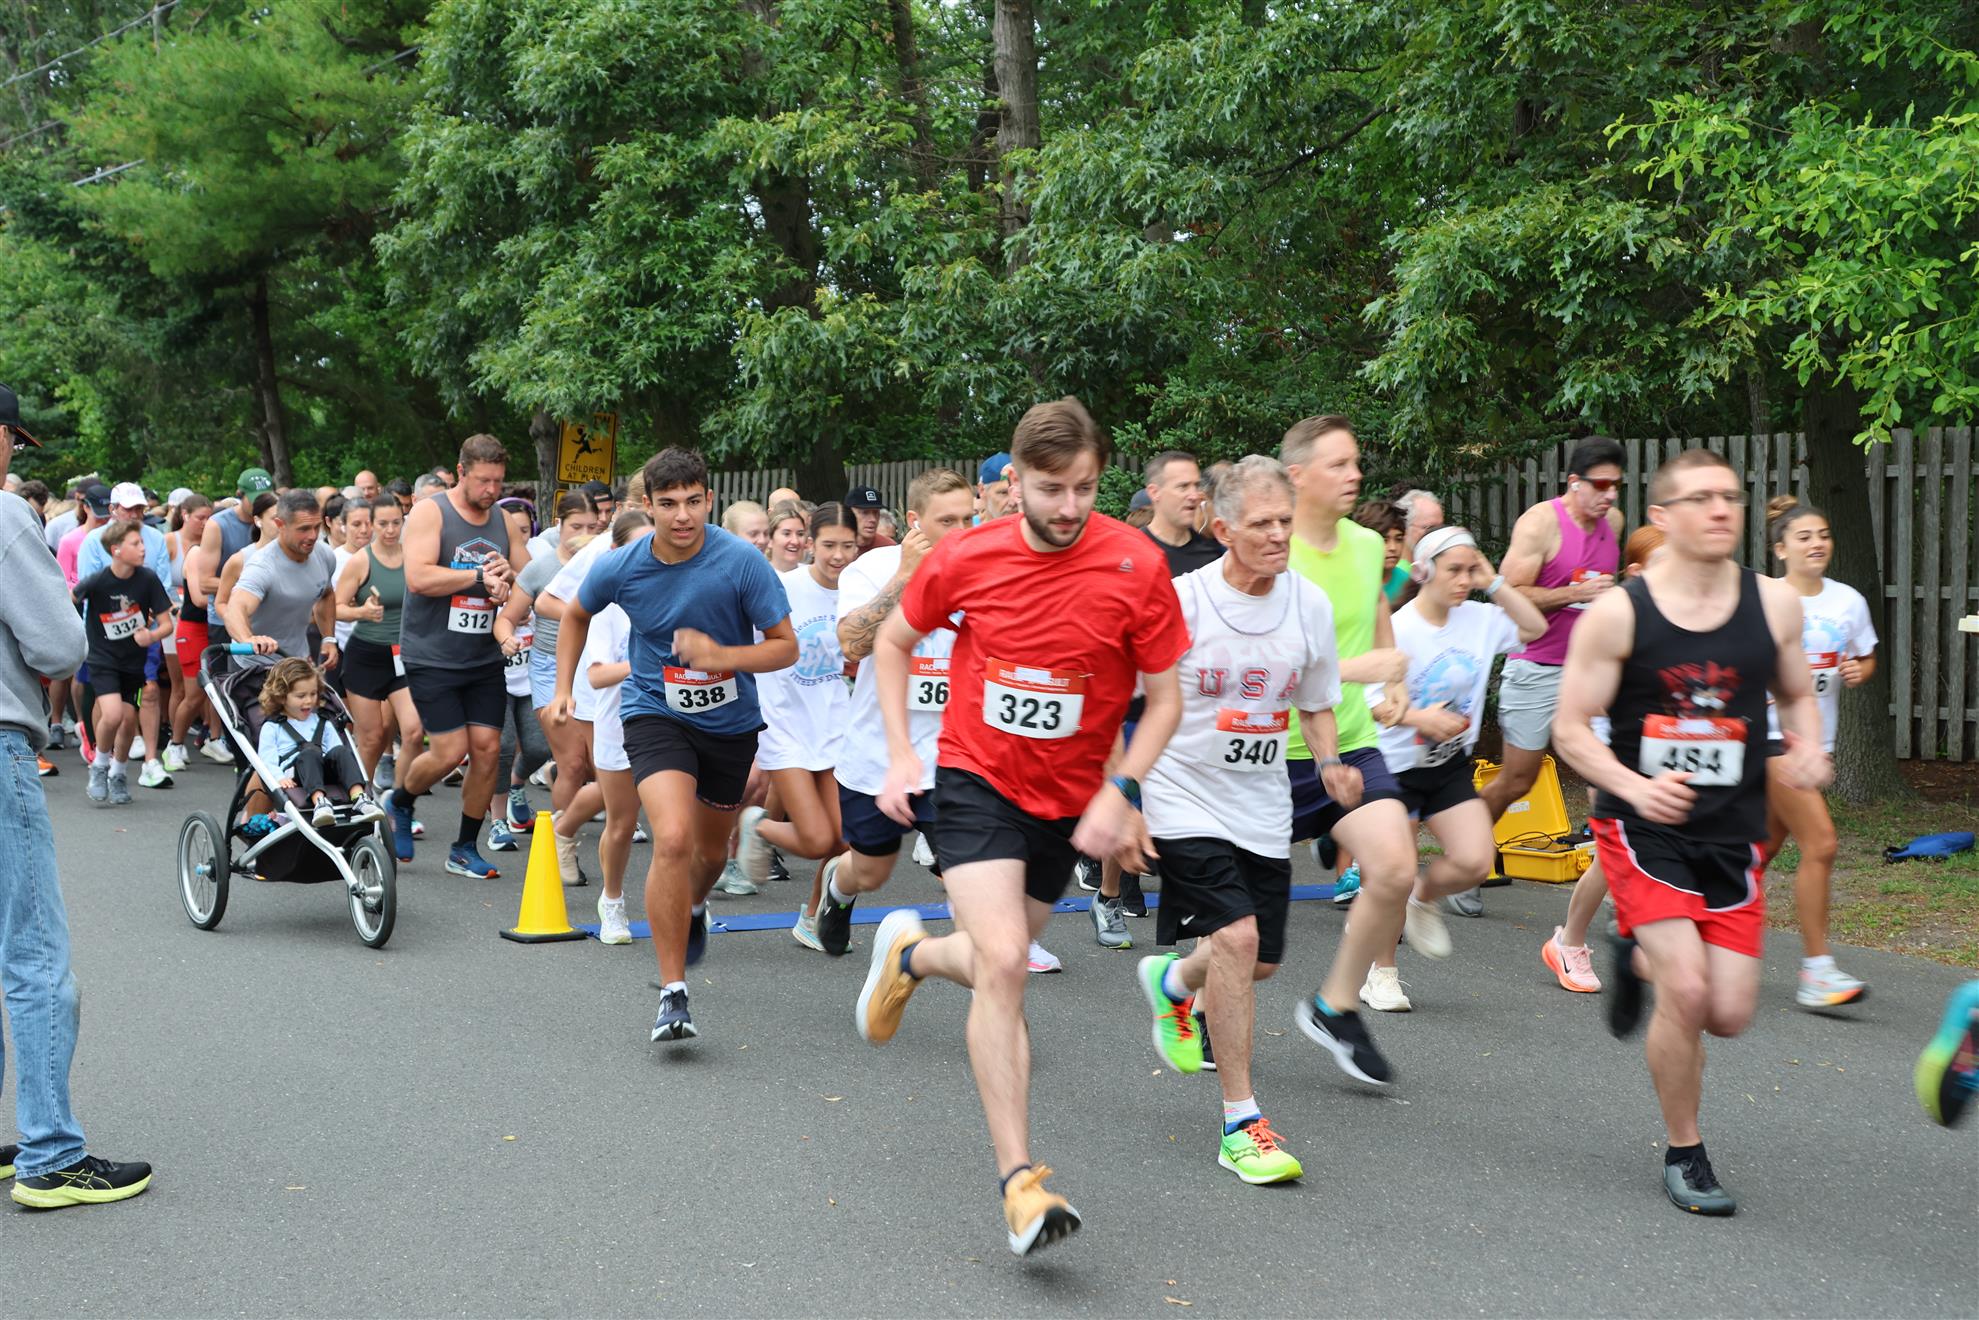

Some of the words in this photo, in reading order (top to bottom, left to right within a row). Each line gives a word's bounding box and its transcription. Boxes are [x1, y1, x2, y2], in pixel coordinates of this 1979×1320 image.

[565, 463, 605, 474] CHILDREN
[567, 472, 577, 480] AT
[581, 473, 601, 481] PLAY
[112, 618, 139, 635] 332
[458, 612, 489, 629] 312
[678, 686, 726, 708] 338
[918, 681, 950, 705] 36
[999, 694, 1062, 731] 323
[1224, 738, 1278, 765] 340
[1660, 747, 1723, 775] 484
